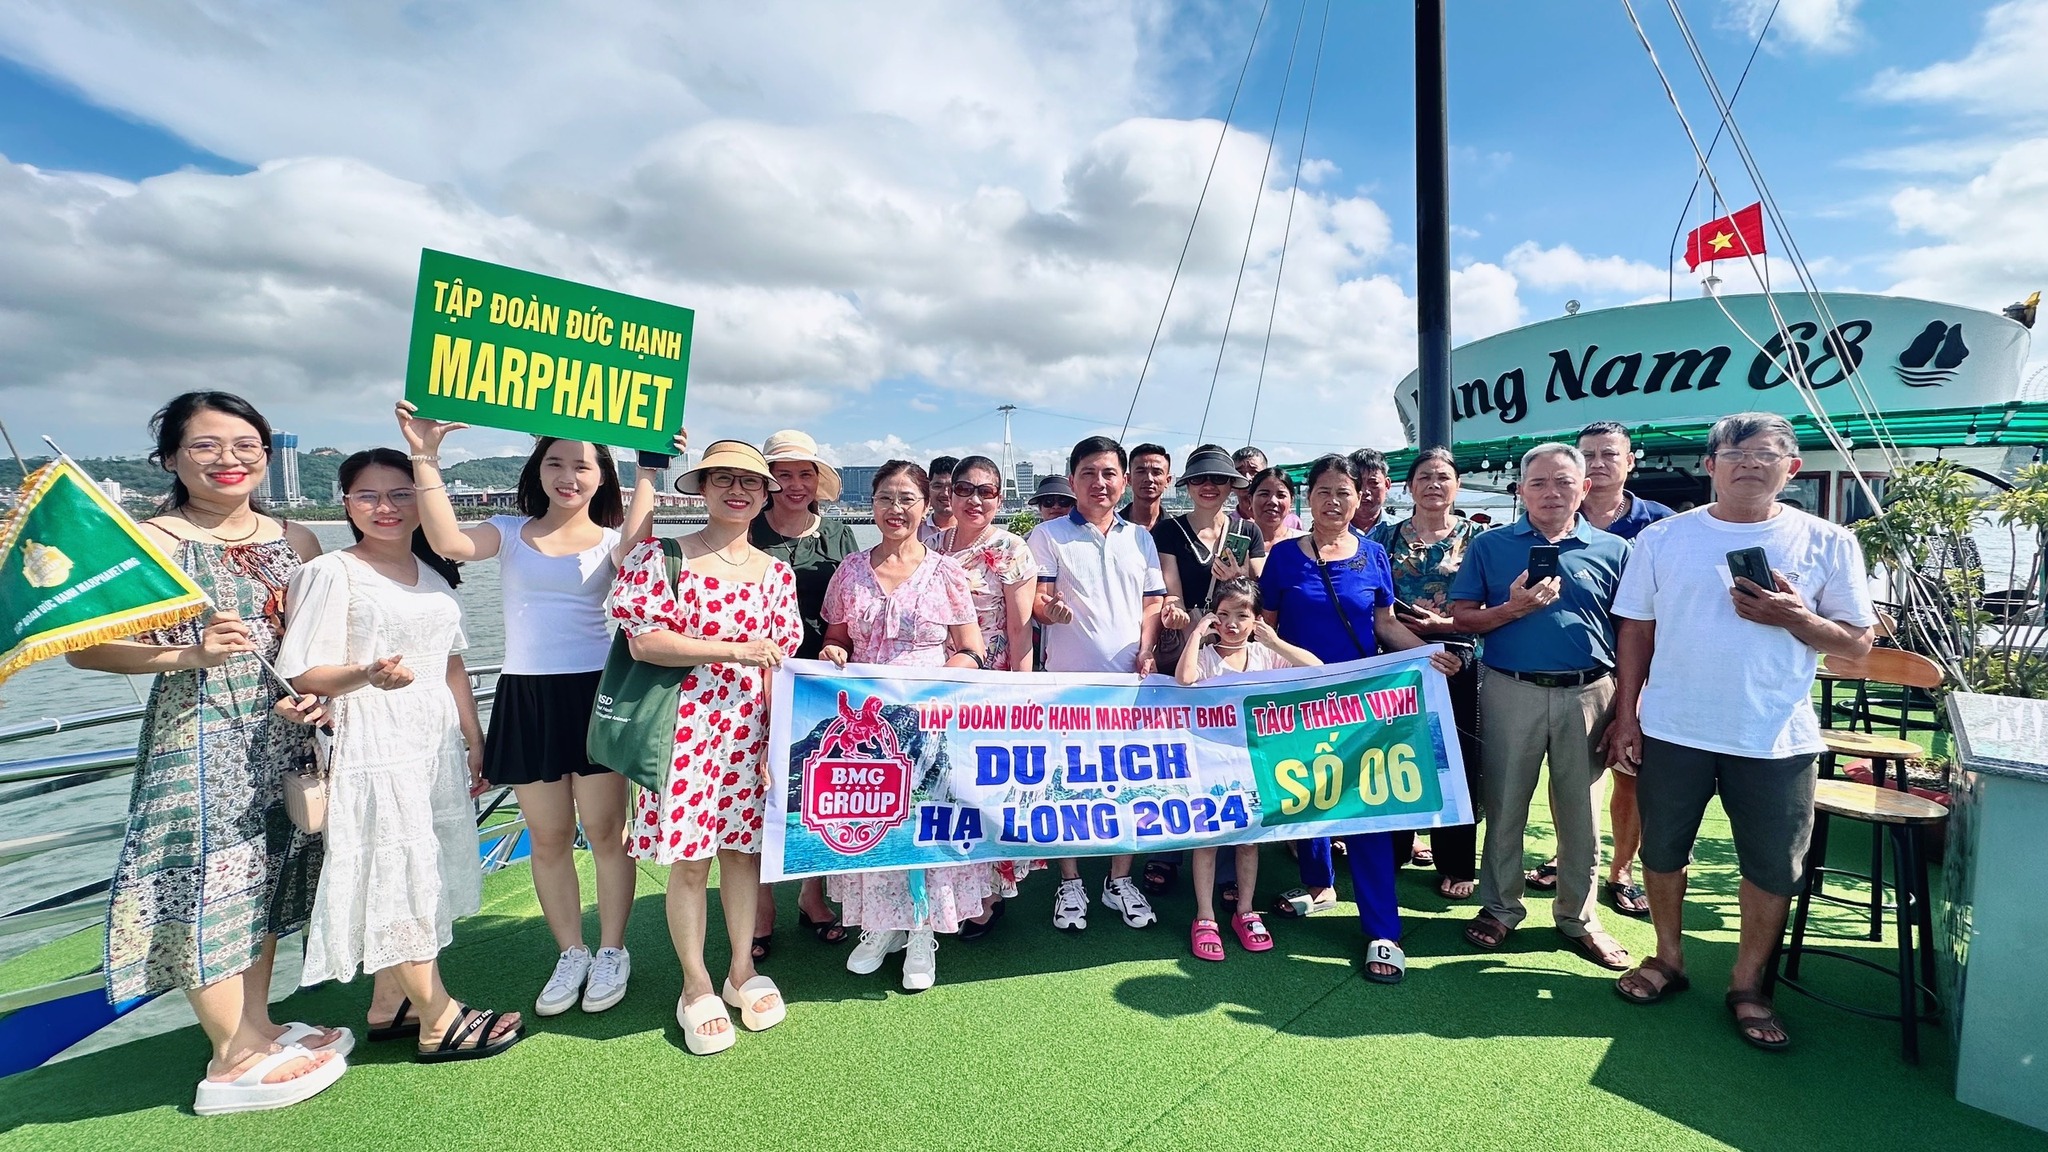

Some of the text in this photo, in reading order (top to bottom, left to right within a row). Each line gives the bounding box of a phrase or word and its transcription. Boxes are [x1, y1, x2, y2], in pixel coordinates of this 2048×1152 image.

[434, 277, 682, 361] TẬP ĐOÀN ĐỨC HẠNH
[428, 333, 673, 432] MARPHAVET
[1545, 344, 1732, 402] Nam
[1747, 319, 1872, 391] 68
[75, 565, 124, 593] MARPHAVET
[119, 557, 142, 572] BMG
[918, 697, 1237, 737] TẬP ĐOÀN ĐỨC HẠNH MARPHAVET BMG
[1251, 686, 1419, 737] TÀU THĂM VỊNH
[830, 767, 886, 784] BMG
[975, 743, 1191, 793] DU LỊCH
[1274, 731, 1423, 815] SỐ 06
[818, 790, 896, 816] GROUP
[918, 794, 1248, 850] HẠ LONG 2024
